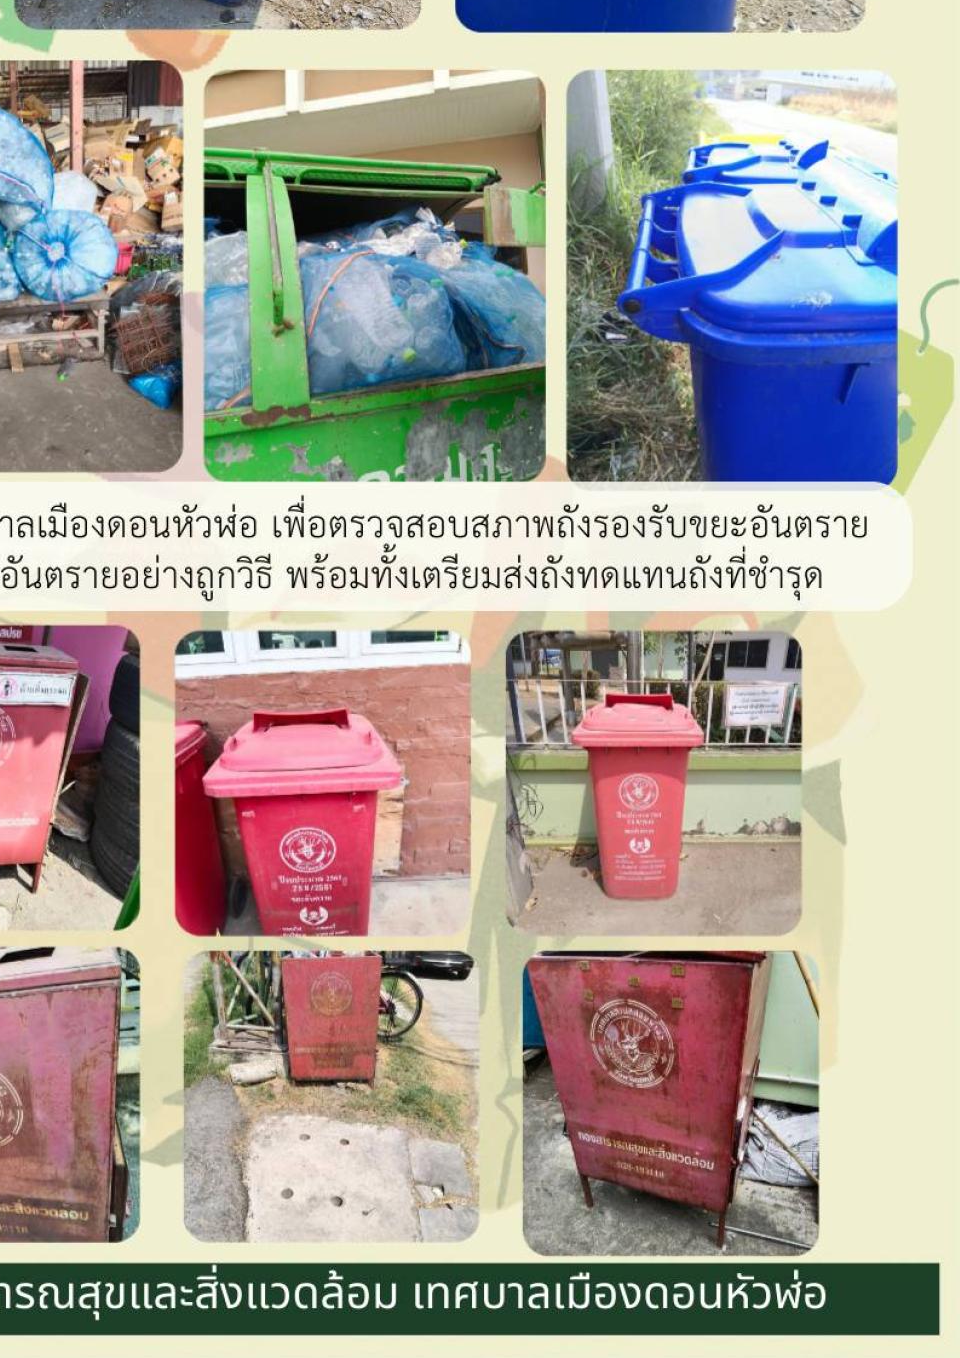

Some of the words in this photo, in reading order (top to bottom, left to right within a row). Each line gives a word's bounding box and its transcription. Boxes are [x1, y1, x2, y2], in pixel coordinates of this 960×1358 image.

[273, 495, 868, 538] เพื่อตรวจสอบสภาพถังรองรับขยะอันตราย
[286, 544, 822, 601] พร้อมทั้งเตรียมส่งถังทดแทนถังที่ชำรุด
[414, 1269, 826, 1310] เทศบาลเมืองดอนหัวฬ่อ
